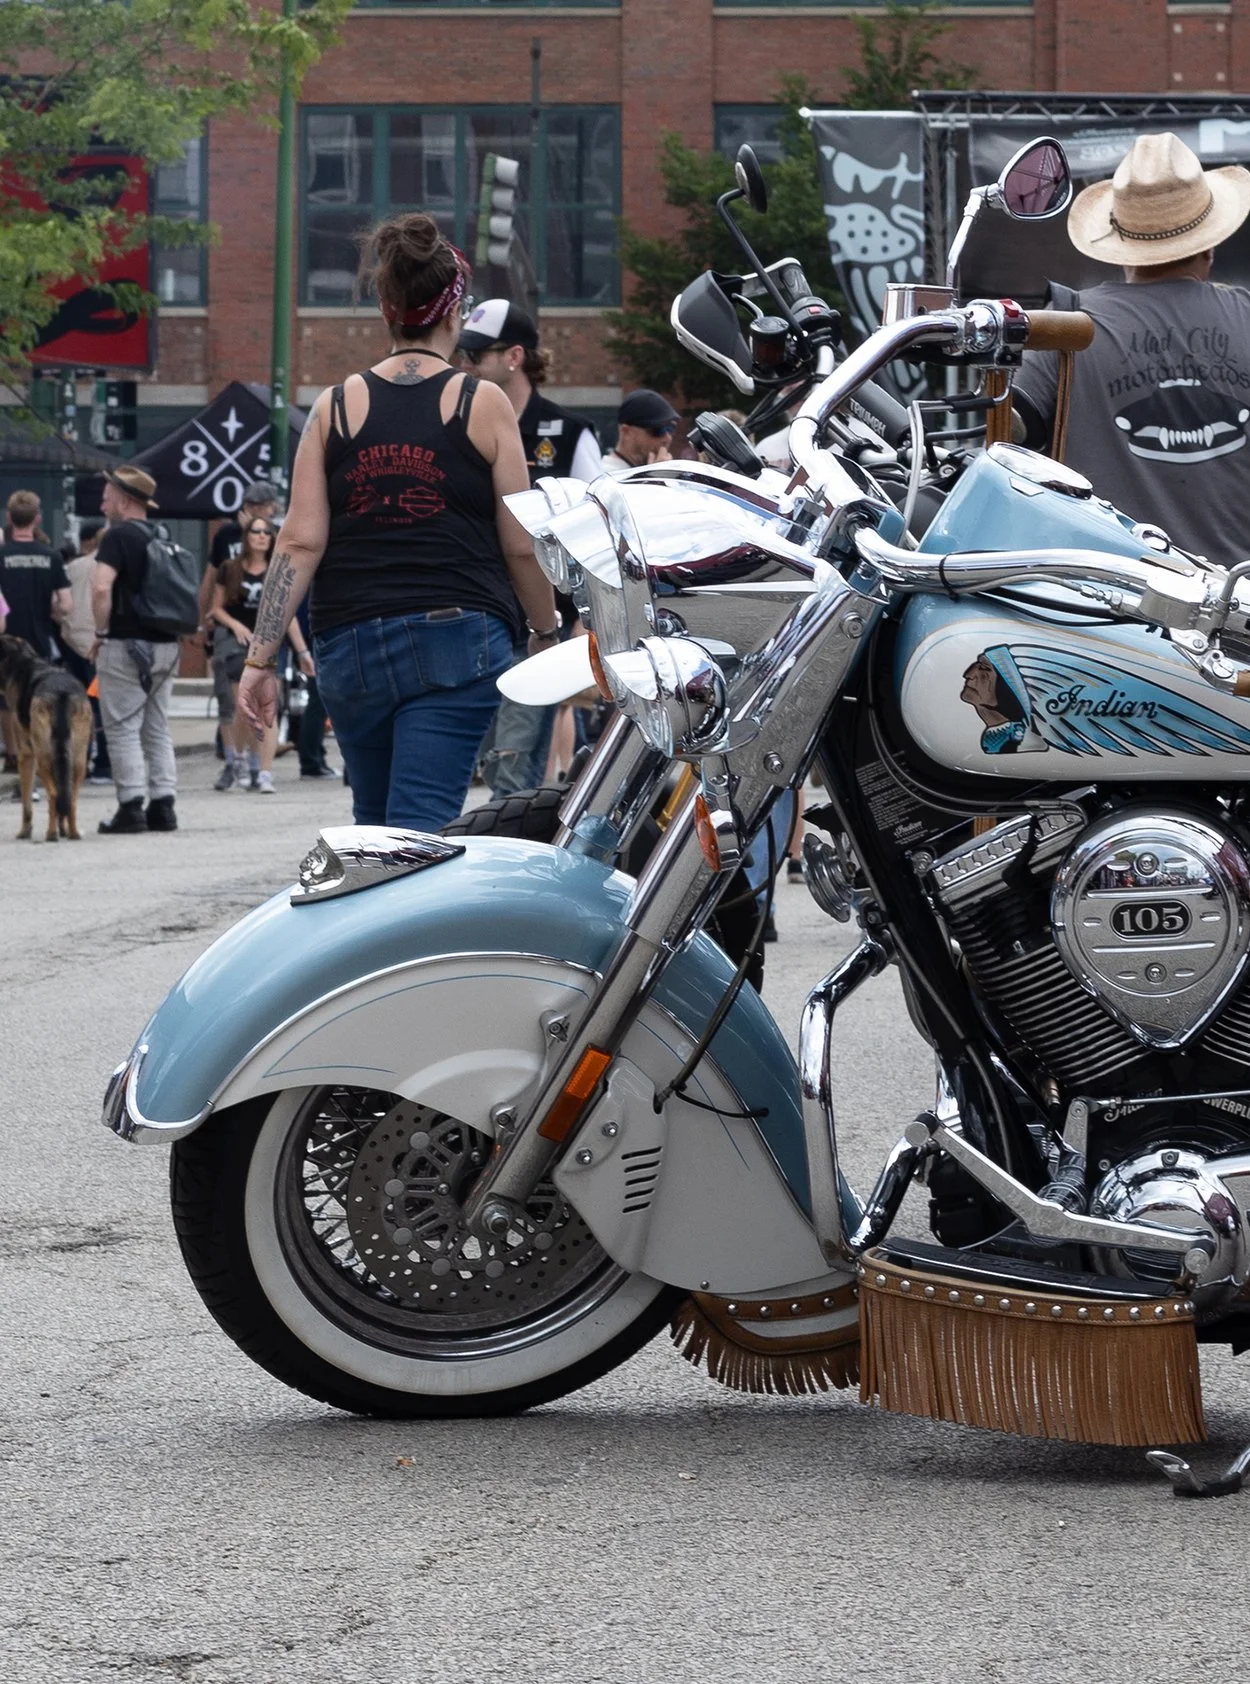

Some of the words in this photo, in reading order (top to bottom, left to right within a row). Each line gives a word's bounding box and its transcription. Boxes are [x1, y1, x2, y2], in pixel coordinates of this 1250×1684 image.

[1188, 326, 1229, 364] City
[850, 397, 886, 437] TRIUMPH
[358, 443, 435, 463] CHICAGO
[392, 457, 447, 480] DAVIDSON
[1045, 684, 1159, 719] Indian
[1119, 906, 1185, 933] 105
